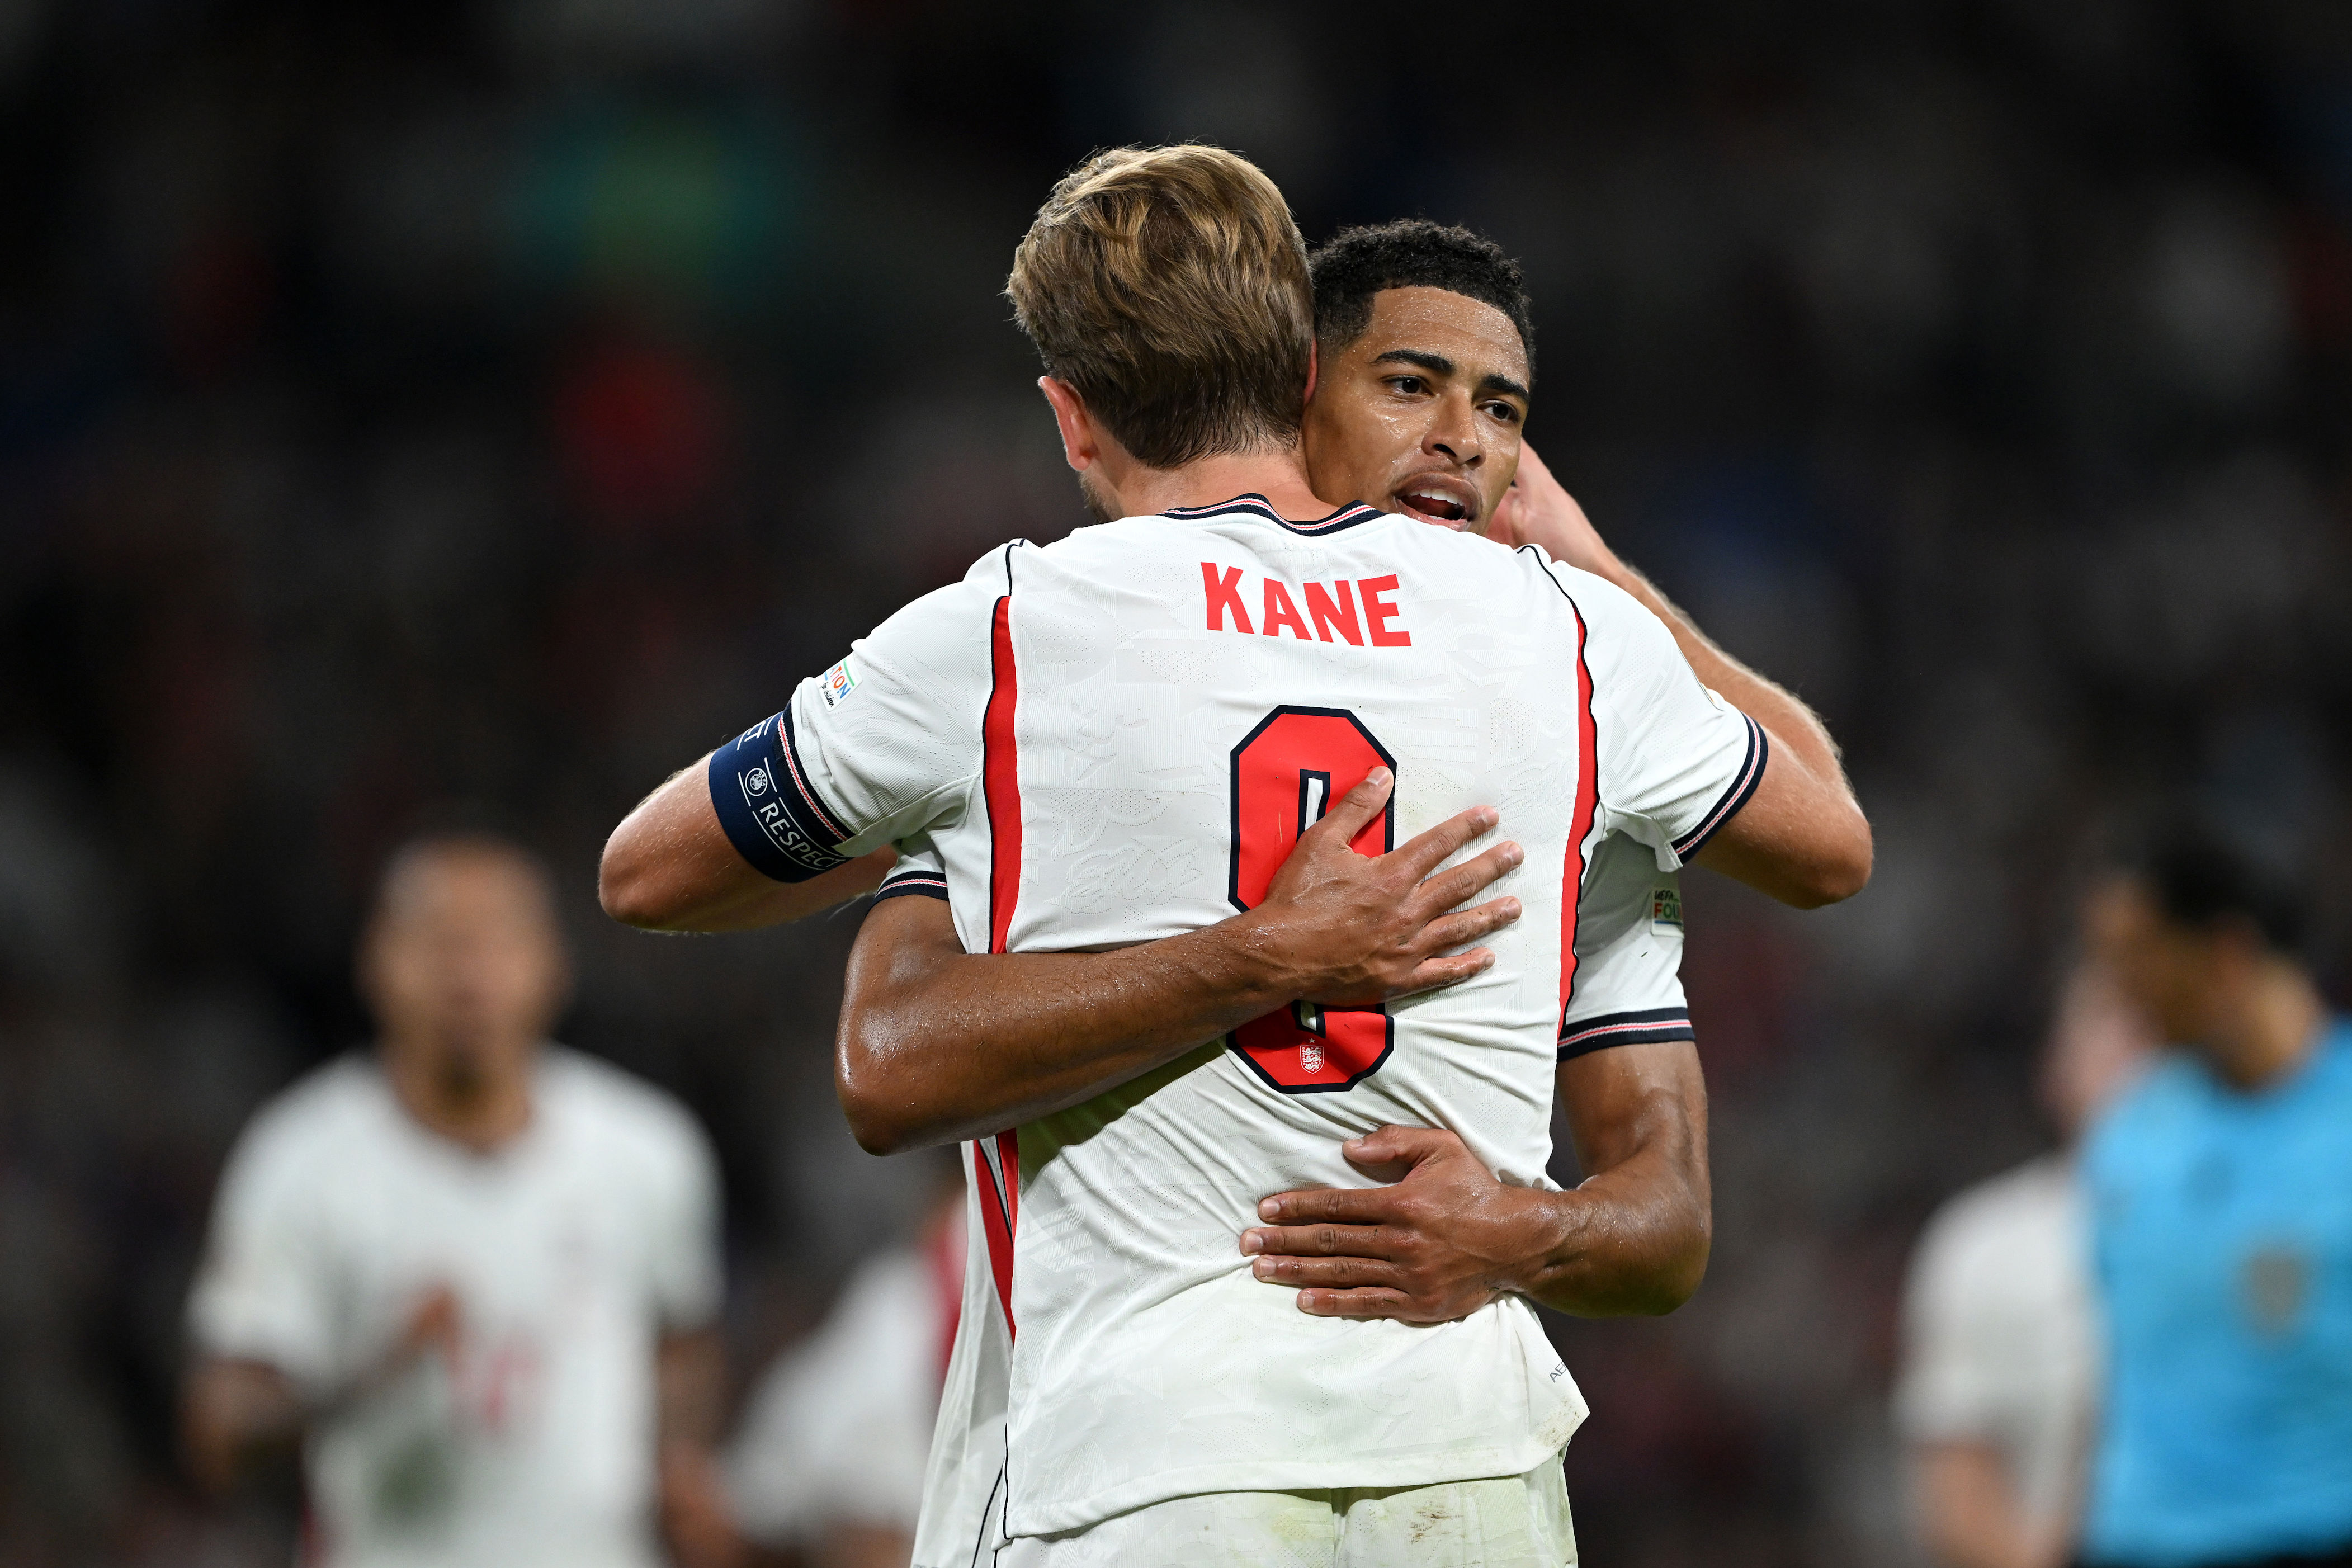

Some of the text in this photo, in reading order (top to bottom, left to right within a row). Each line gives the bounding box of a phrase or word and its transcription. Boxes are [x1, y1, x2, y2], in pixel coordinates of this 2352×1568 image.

[1201, 562, 1411, 646] KANE
[823, 689, 834, 707] children
[759, 802, 846, 867] RESPECT
